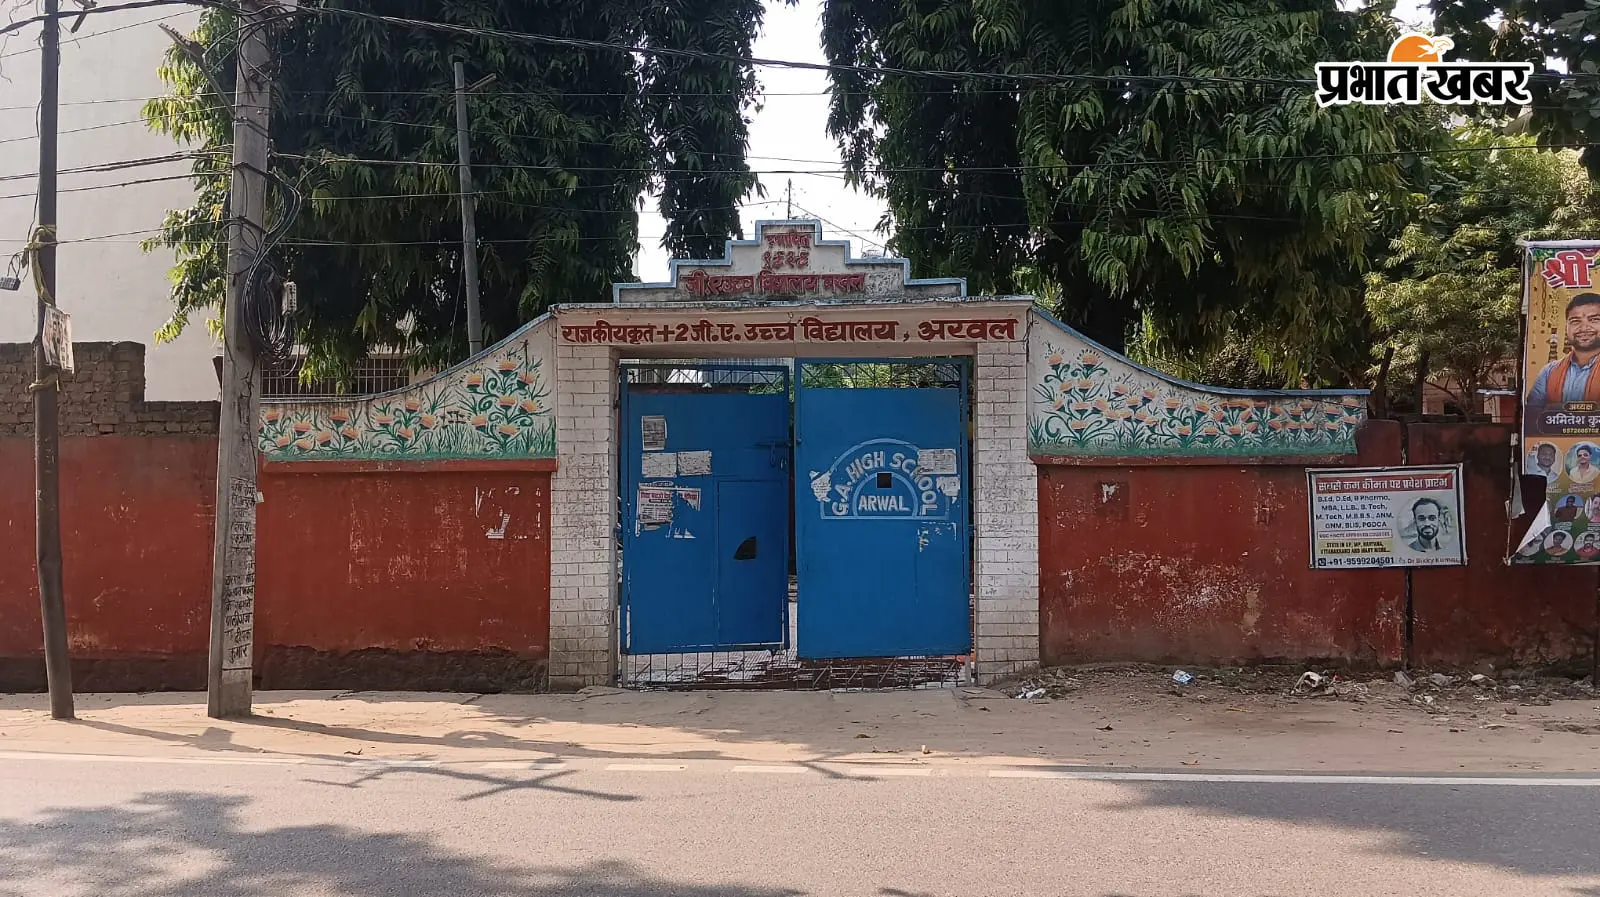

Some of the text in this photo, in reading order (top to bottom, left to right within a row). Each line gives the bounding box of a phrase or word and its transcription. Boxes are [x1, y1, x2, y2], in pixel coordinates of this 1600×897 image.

[1542, 251, 1594, 288] श्री
[917, 317, 1019, 341] अरवल
[1545, 412, 1586, 425] अमितेश
[845, 450, 886, 483] HIGH
[1362, 477, 1388, 489] कीमत
[1389, 479, 1401, 489] पर
[1402, 476, 1423, 489] प्रवेश
[857, 494, 912, 513] ARWAL
